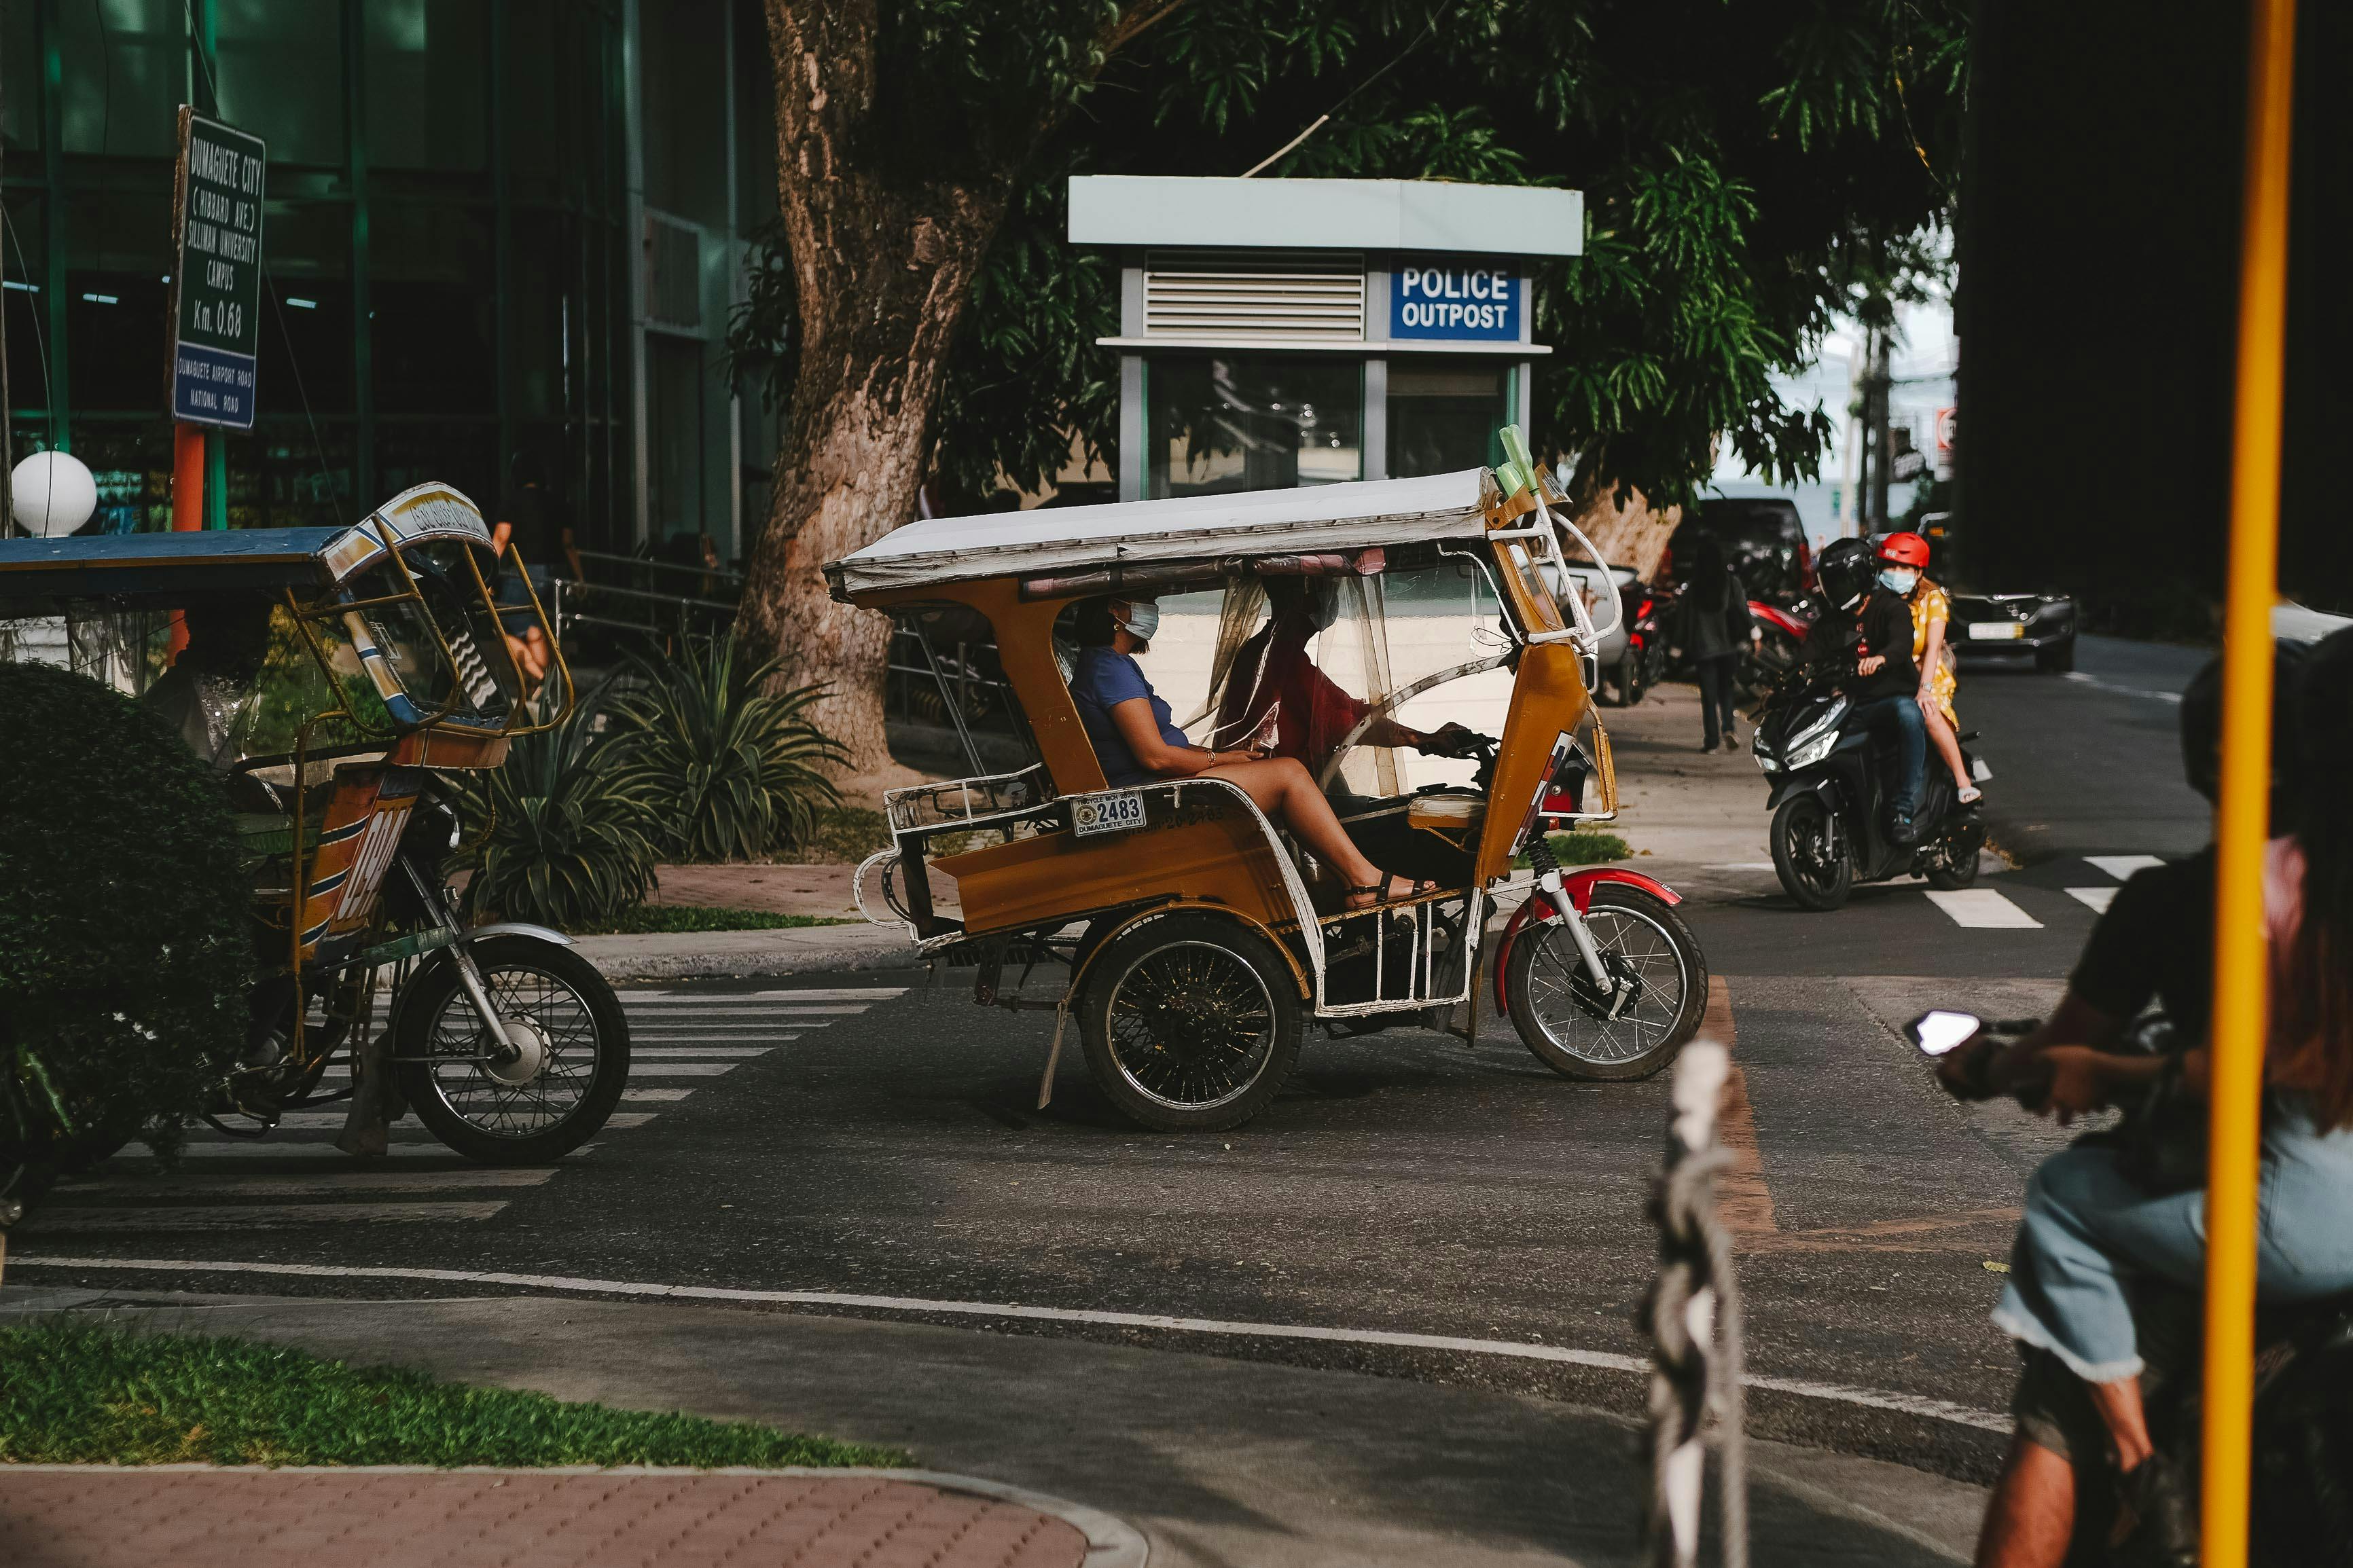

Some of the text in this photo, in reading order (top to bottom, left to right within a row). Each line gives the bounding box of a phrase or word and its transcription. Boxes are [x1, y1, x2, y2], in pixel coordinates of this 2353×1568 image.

[191, 136, 262, 196] DUMAGUETE CITY
[234, 200, 255, 233] AVE.)
[187, 219, 256, 265] SILLIMAN UNIVERSITY
[206, 259, 234, 291] CAMPUS
[1402, 268, 1509, 299] POLICE
[194, 299, 241, 338] Km. 0.68
[1402, 302, 1509, 329] OUTPOST
[178, 357, 252, 388] DUMAGUETE AIRPORT ROAD
[190, 388, 239, 414] NATIONAL ROAD
[1097, 798, 1140, 823] 2483
[1079, 821, 1122, 833] DUMAGUETE
